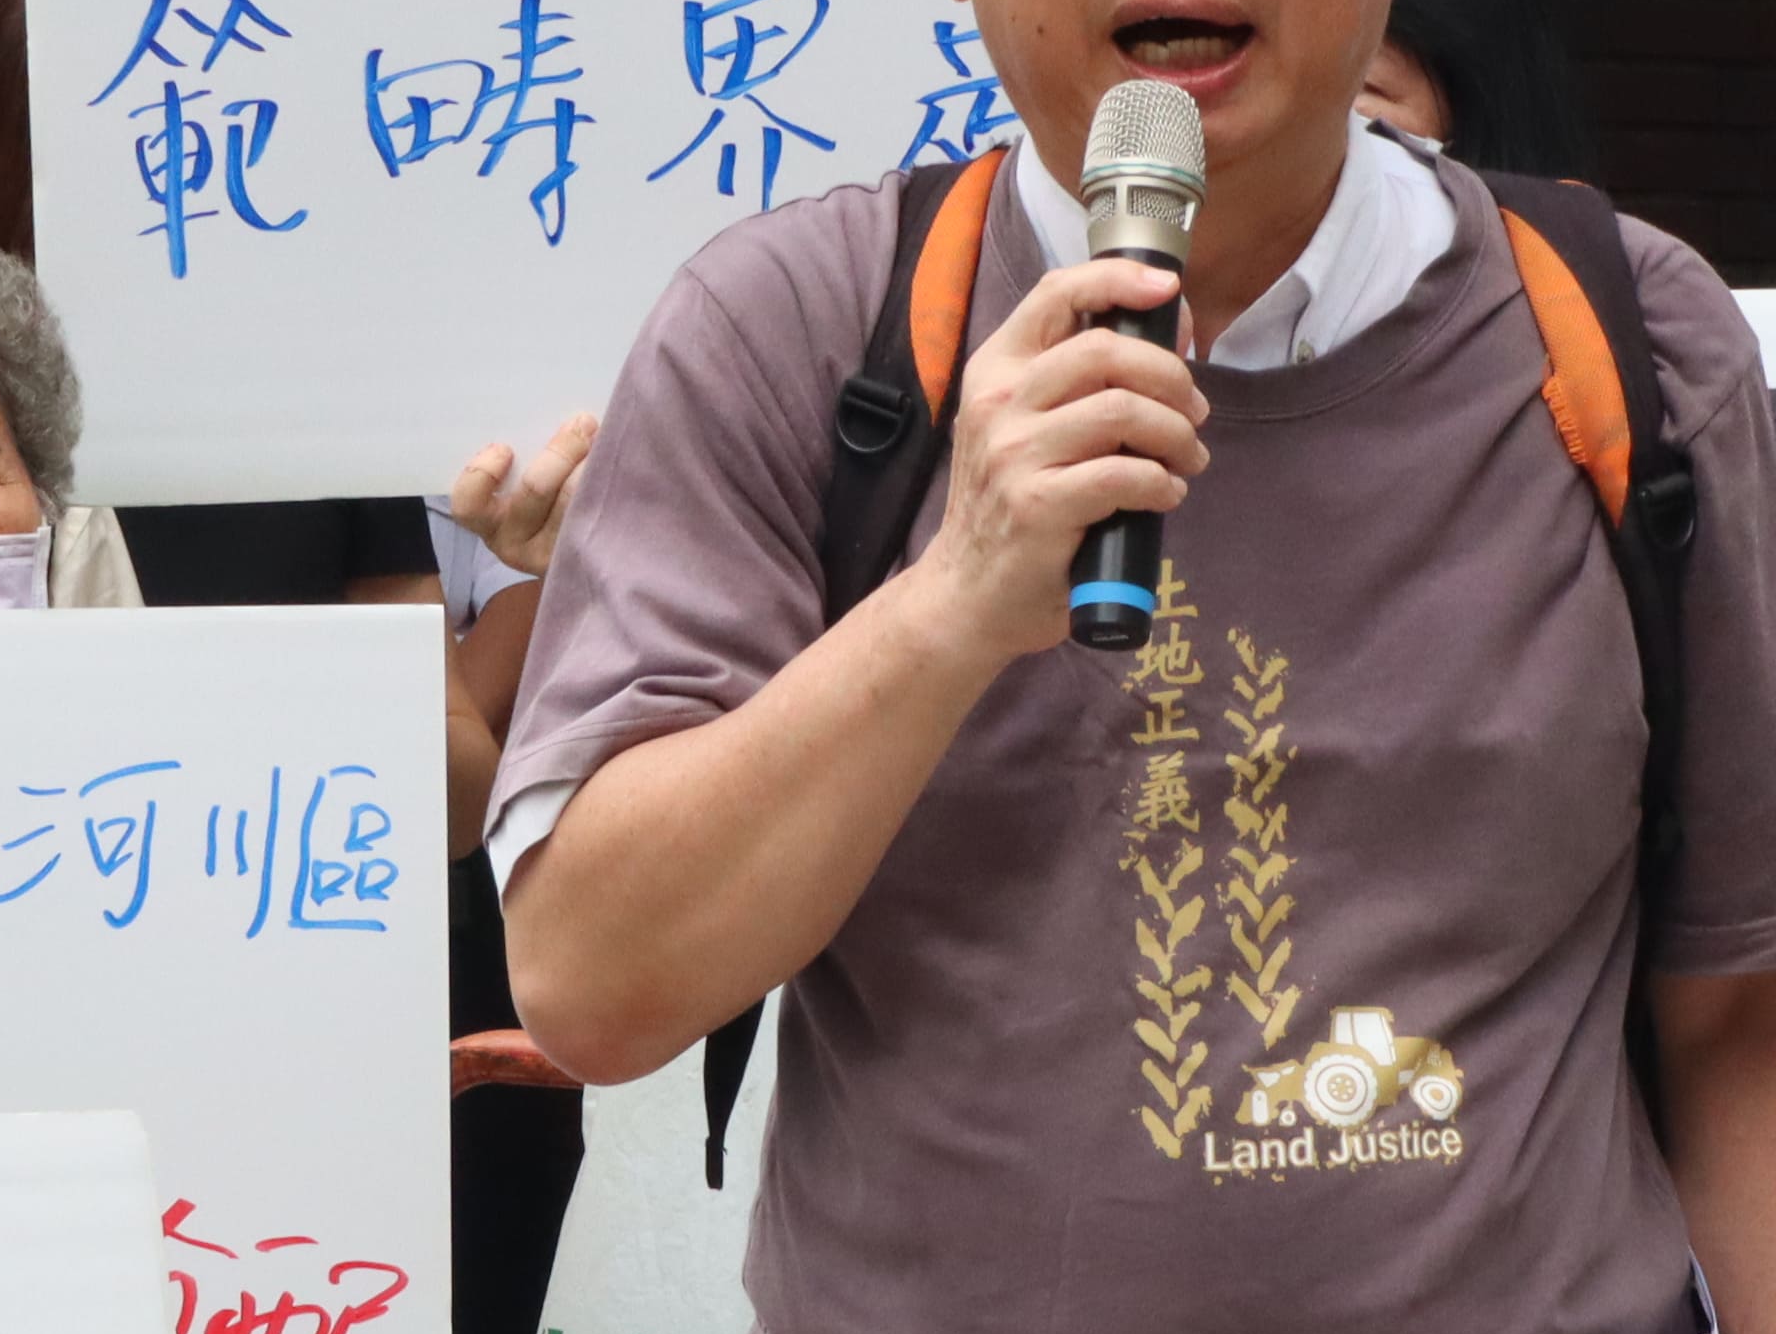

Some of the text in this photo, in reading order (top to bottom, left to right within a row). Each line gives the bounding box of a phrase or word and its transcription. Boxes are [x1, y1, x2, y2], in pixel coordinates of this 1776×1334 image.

[1126, 558, 1205, 834] 土地正義
[1203, 1122, 1464, 1171] Land Justice
